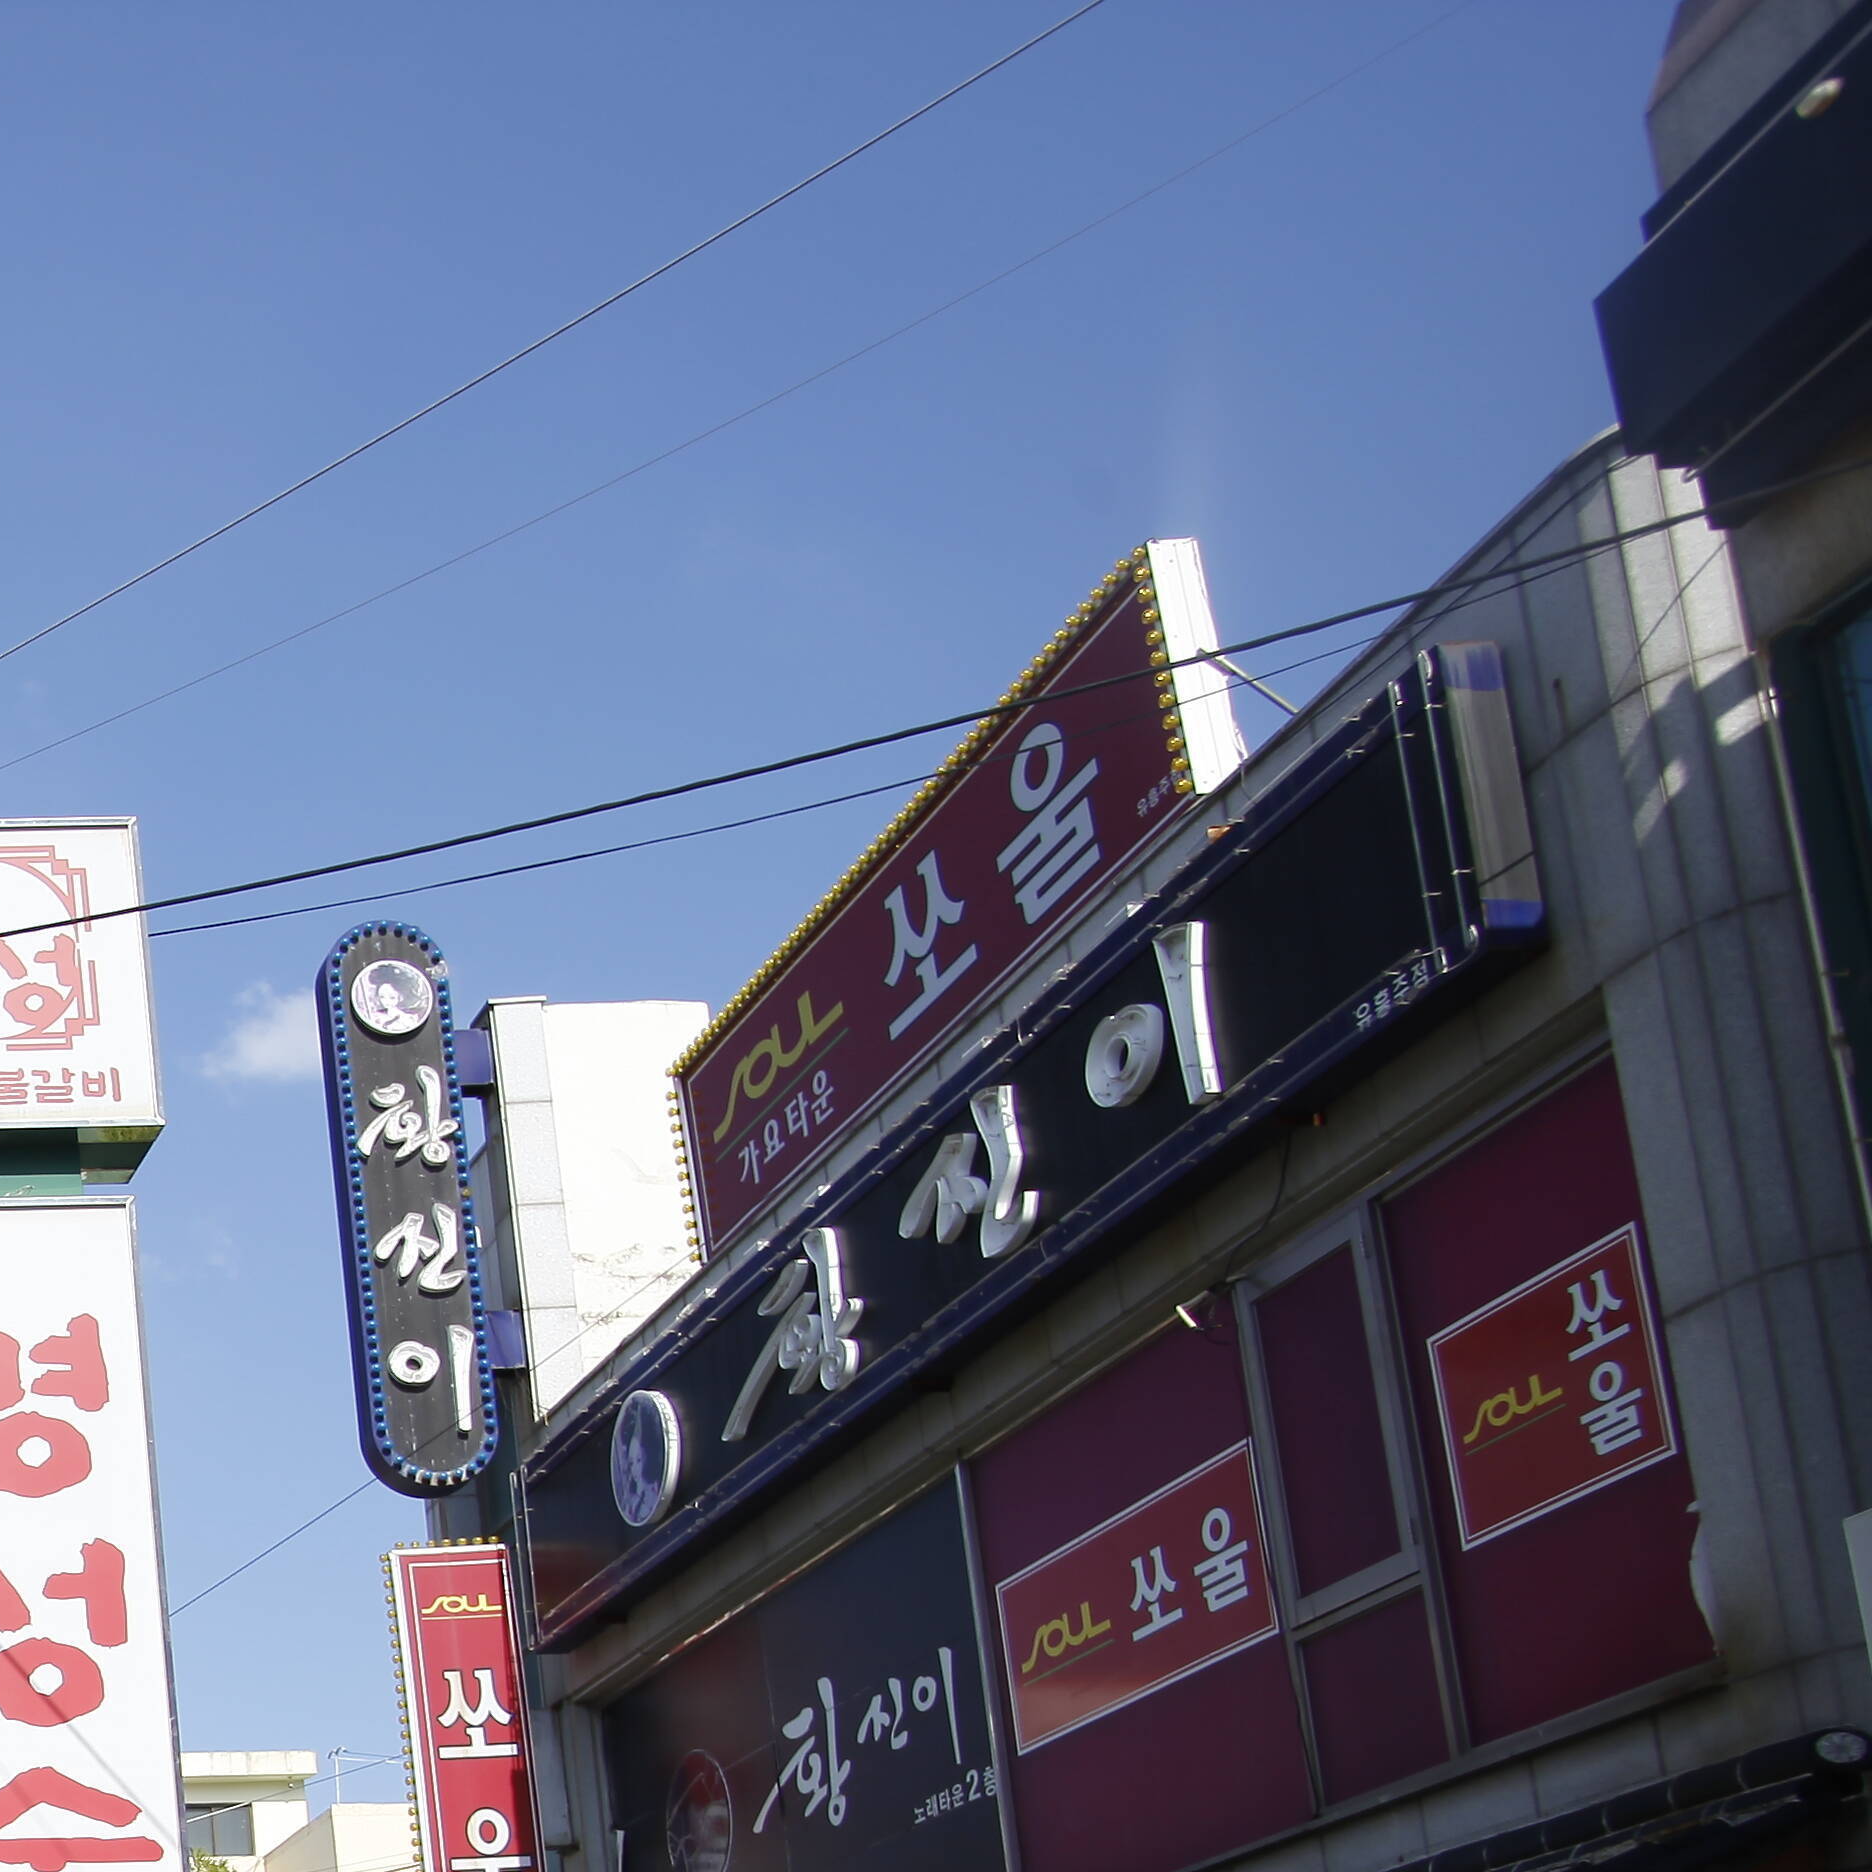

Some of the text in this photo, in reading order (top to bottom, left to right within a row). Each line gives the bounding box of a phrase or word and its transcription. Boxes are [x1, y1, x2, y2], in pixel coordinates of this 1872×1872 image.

[1137, 768, 1186, 817] 유흥주
[883, 722, 1102, 1040] 쏘울
[1354, 959, 1430, 1031] 유흥주점
[713, 989, 844, 1143] SOUL
[738, 1069, 834, 1185] 가요타운
[1565, 1270, 1643, 1456] 쏘울
[1463, 1375, 1563, 1444] SOUL
[420, 1594, 503, 1615] SOUL
[1129, 1507, 1249, 1641] 쏘울
[1021, 1602, 1112, 1674] SOUL
[913, 1783, 964, 1826] 노래타운
